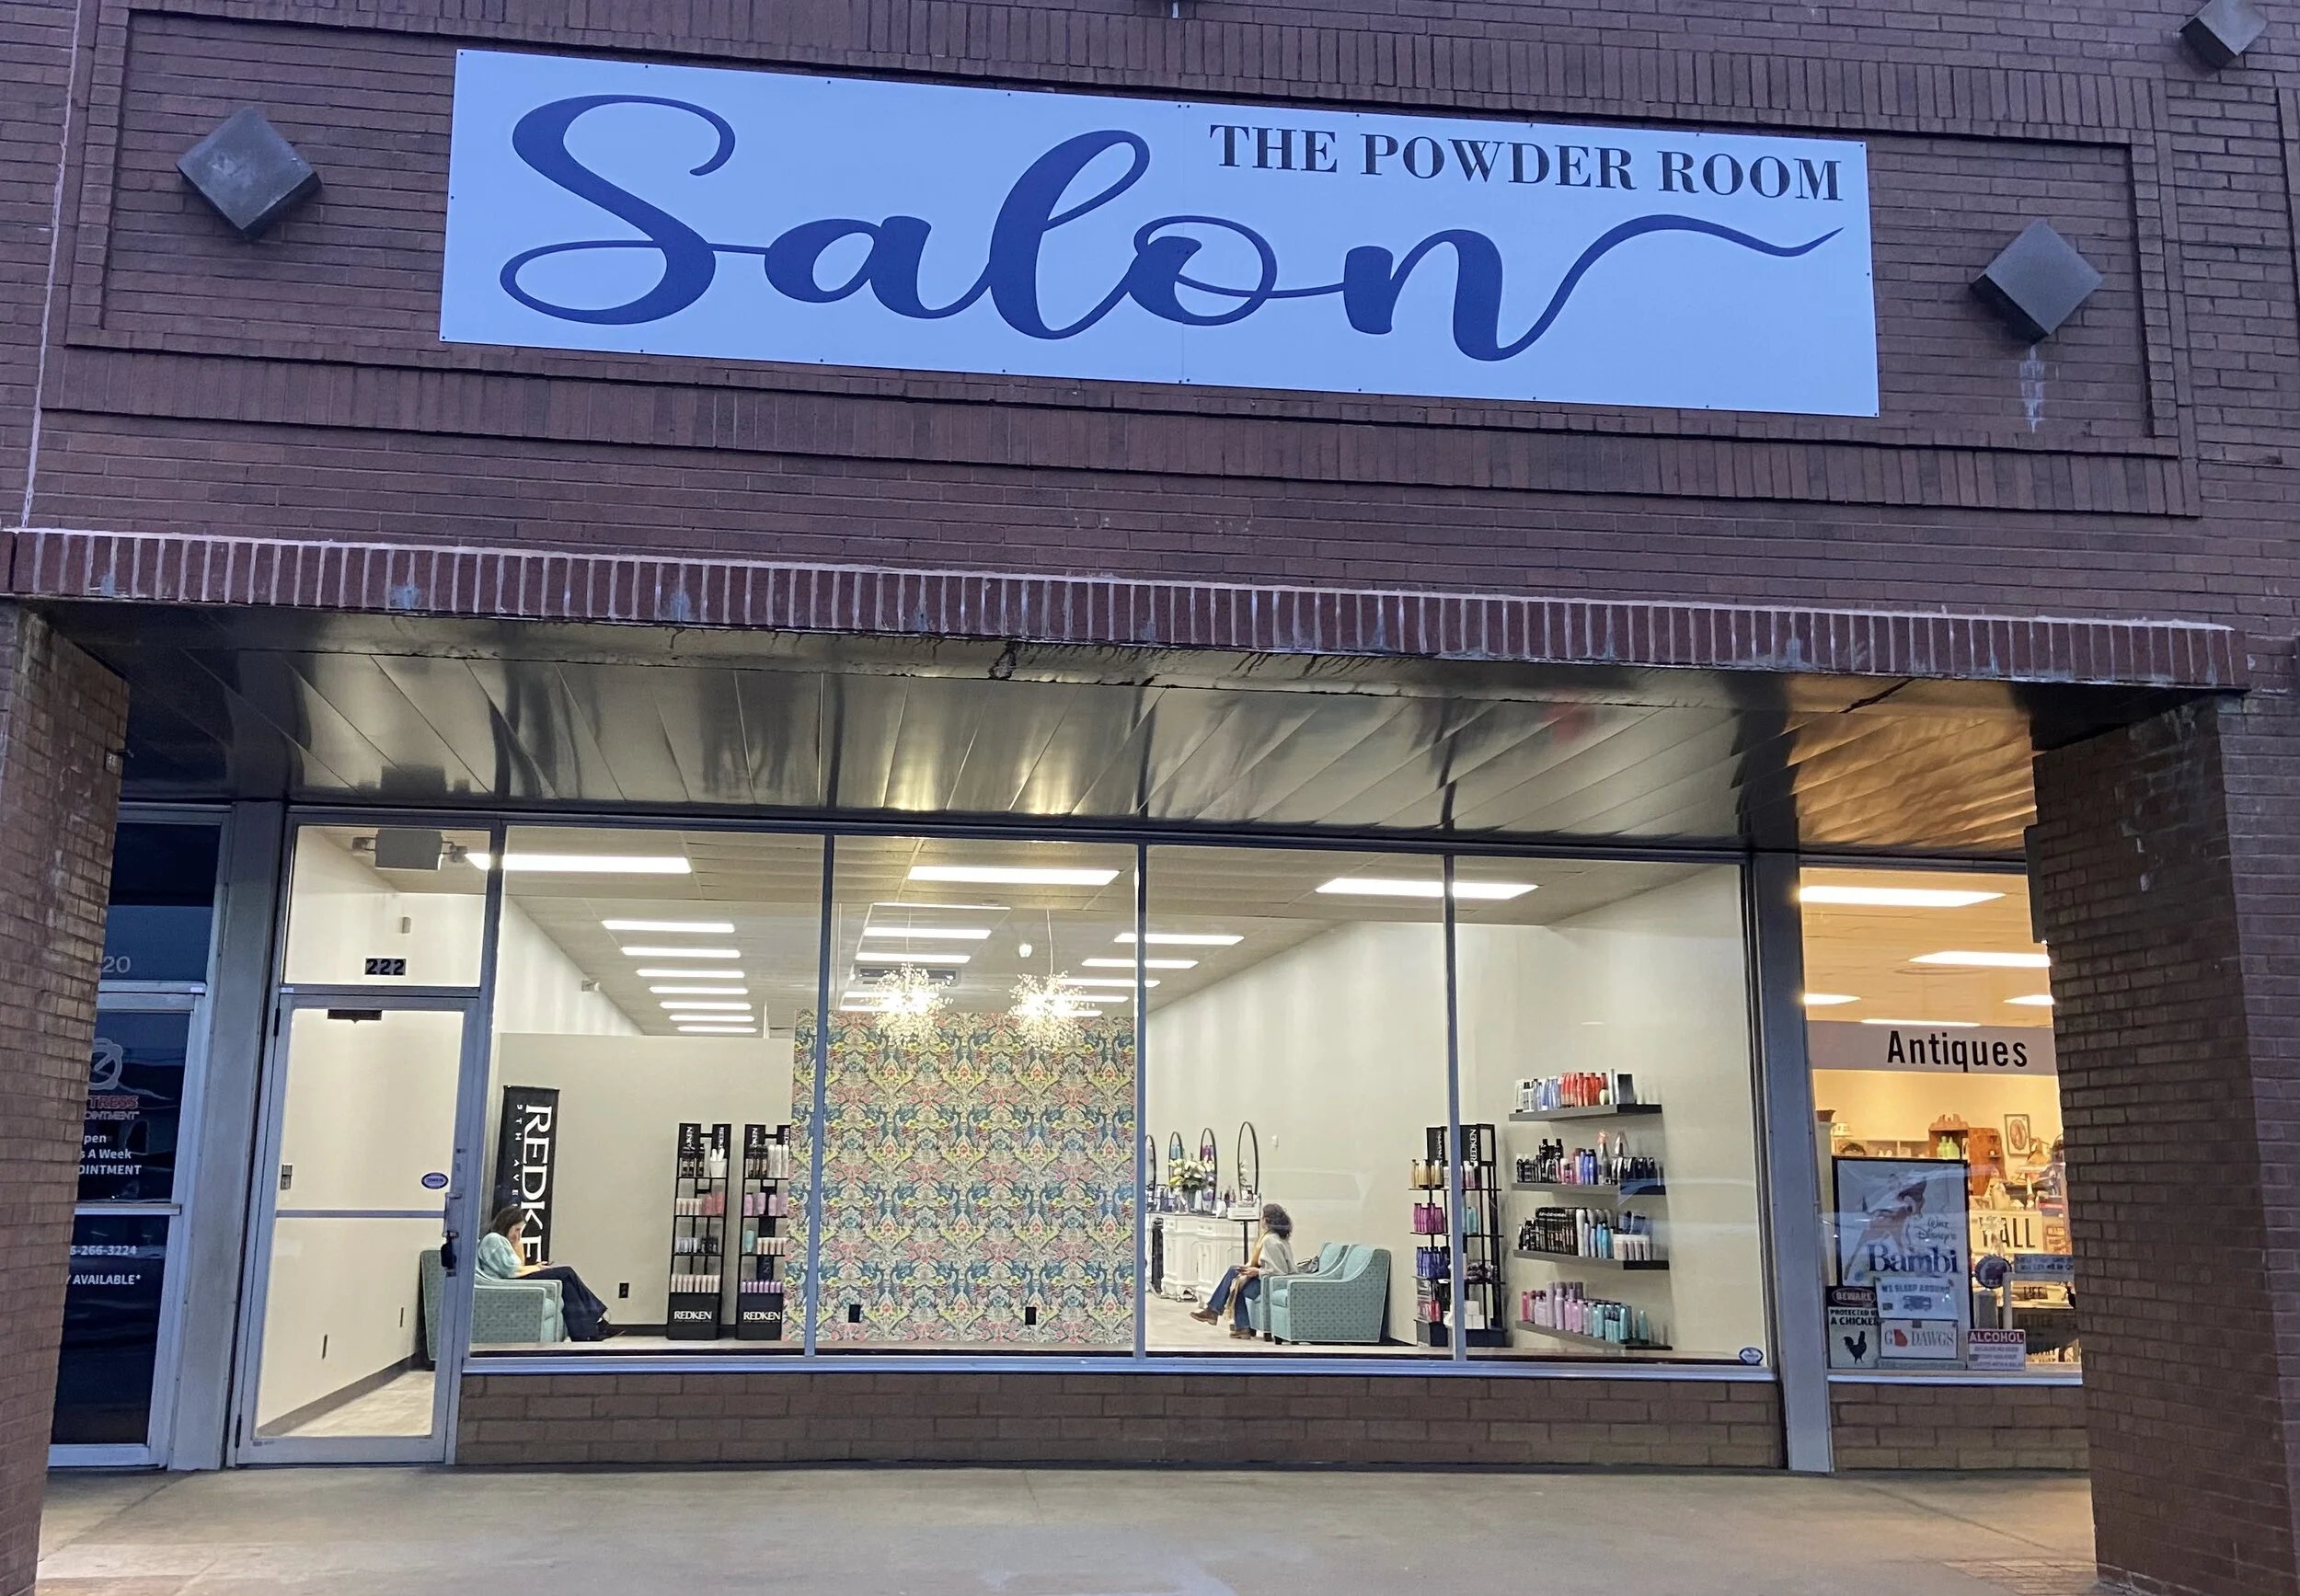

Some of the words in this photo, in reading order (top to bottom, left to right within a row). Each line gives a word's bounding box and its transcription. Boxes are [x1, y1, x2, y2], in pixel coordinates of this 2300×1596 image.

[1210, 124, 1338, 173] THE
[1360, 132, 1639, 190] POWDER
[1656, 149, 1844, 202] ROOM
[500, 94, 1844, 361] Salon
[366, 959, 405, 975] 222
[1887, 1030, 2028, 1073] Antiques
[87, 1149, 97, 1159] A
[99, 1148, 132, 1159] Week
[1979, 1217, 2036, 1247] YALL
[1867, 1244, 1959, 1272] Bambi
[1834, 1292, 1873, 1301] BEWARE
[673, 1311, 713, 1320] REDKEN
[743, 1312, 781, 1320] REDKEN
[1830, 1316, 1837, 1325] A
[1911, 1331, 1955, 1347] DAWGS
[1969, 1332, 2024, 1343] ALCOHOL
